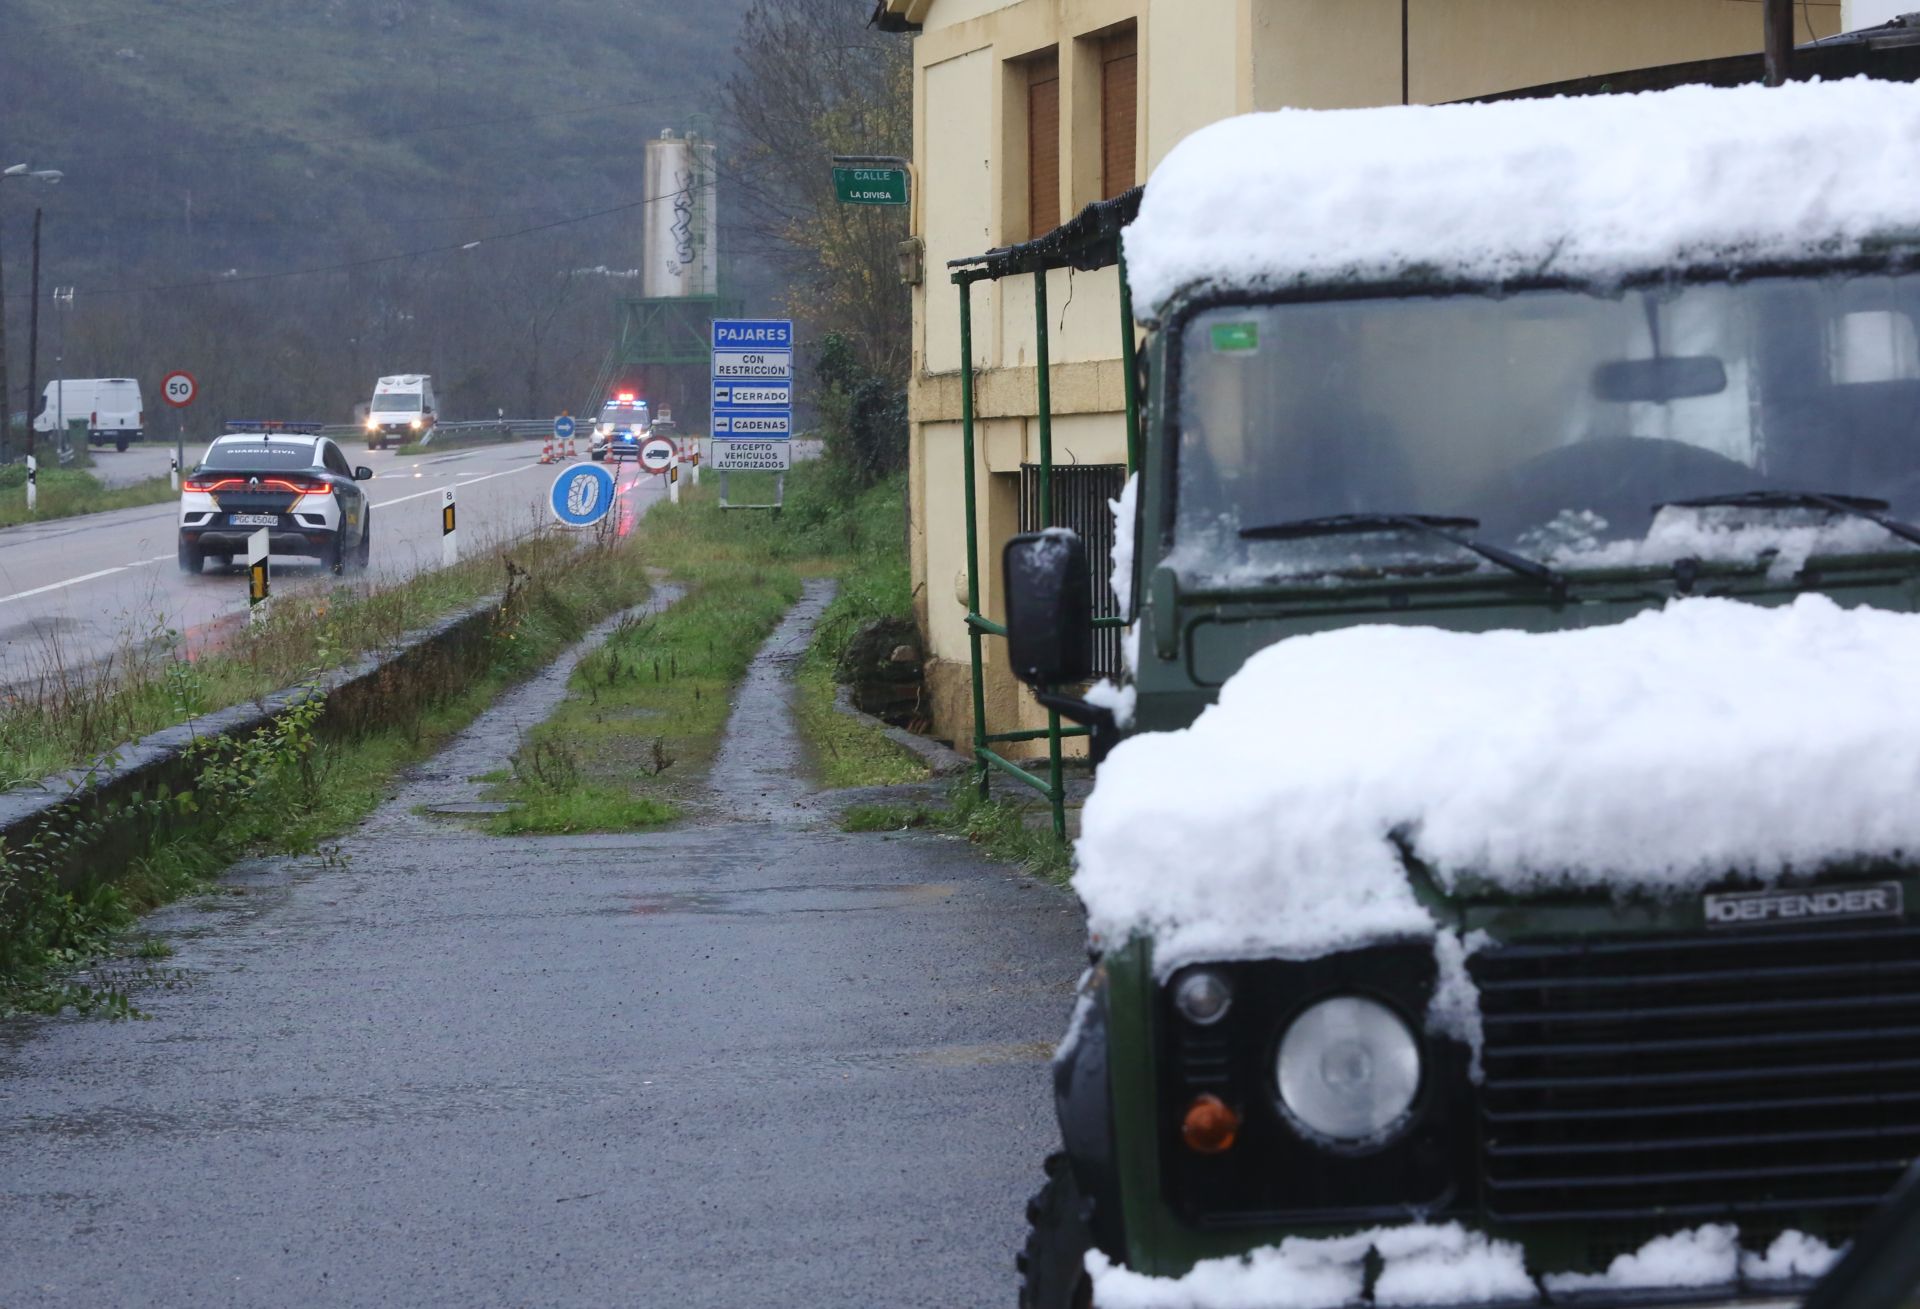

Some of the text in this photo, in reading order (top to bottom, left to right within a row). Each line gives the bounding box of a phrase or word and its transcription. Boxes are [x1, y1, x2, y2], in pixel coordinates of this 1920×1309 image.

[854, 171, 891, 181] CALLE
[849, 190, 891, 199] LA DIVISA
[717, 328, 787, 341] PAJARES
[742, 354, 764, 364] CON
[170, 383, 189, 396] 50
[734, 392, 787, 401] CERRADO
[734, 421, 787, 430] CADENAS
[730, 443, 772, 451] EXCEPTO
[718, 461, 785, 469] AUTORIZADOS
[446, 491, 453, 501] 8
[234, 515, 250, 524] PGC
[1714, 888, 1887, 922] DEFENDER
